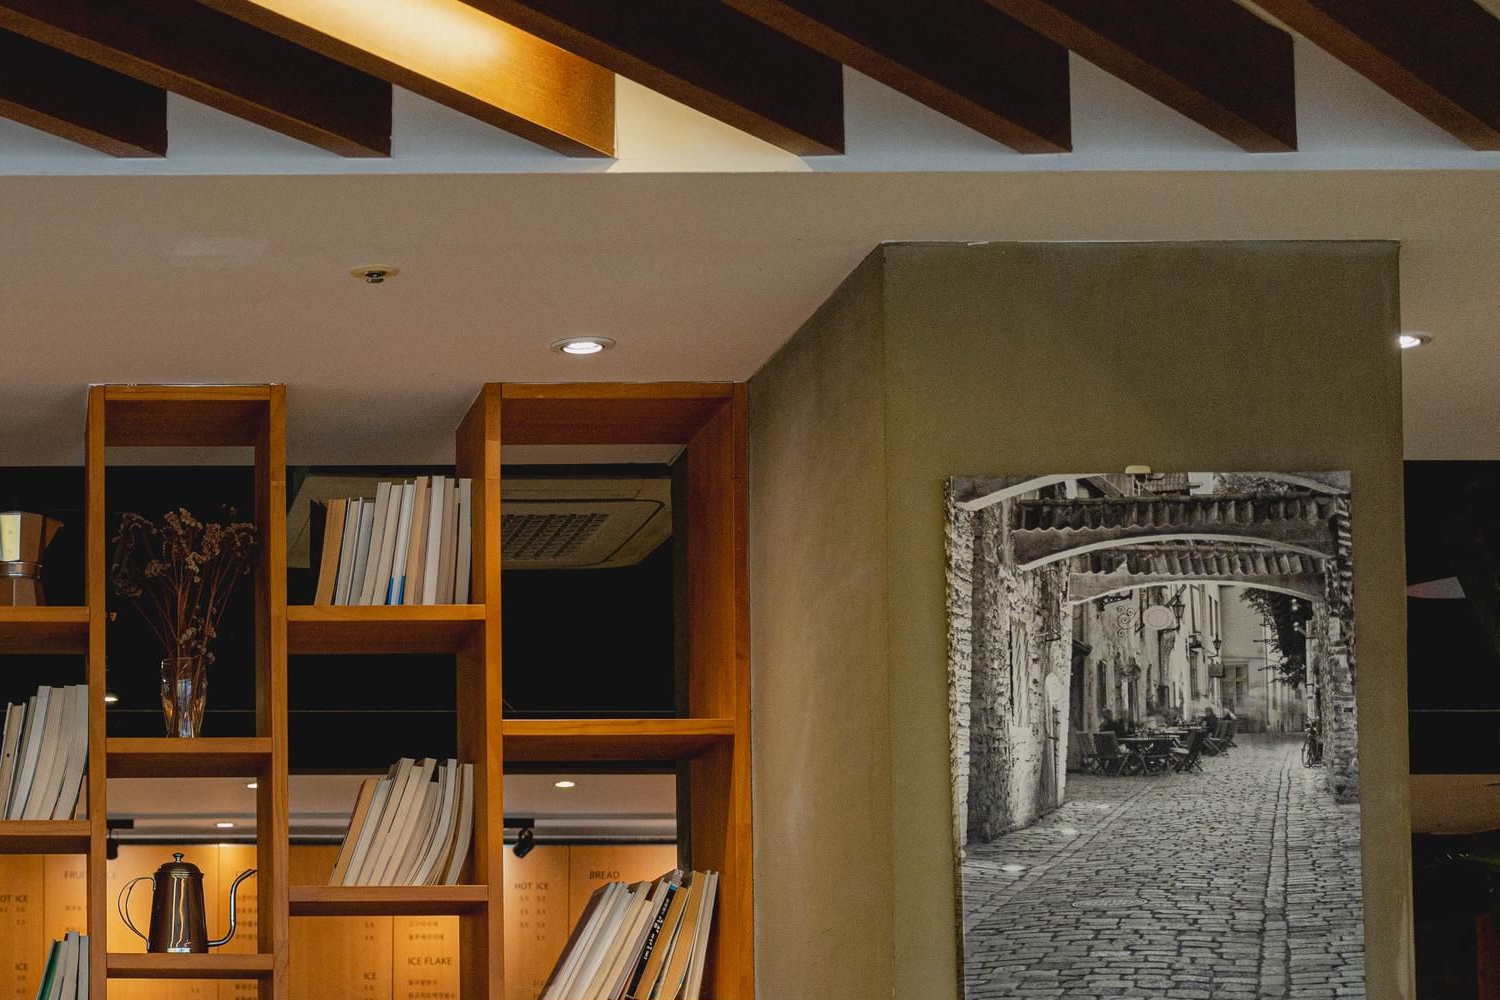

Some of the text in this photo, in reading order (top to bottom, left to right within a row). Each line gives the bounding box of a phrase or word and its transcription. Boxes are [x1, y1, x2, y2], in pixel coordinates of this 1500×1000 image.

[589, 871, 620, 879] BREAD
[514, 882, 548, 890] HOT ICE
[15, 895, 28, 903] ICE
[408, 957, 452, 966] ICE FLAKE
[363, 972, 376, 980] ICE
